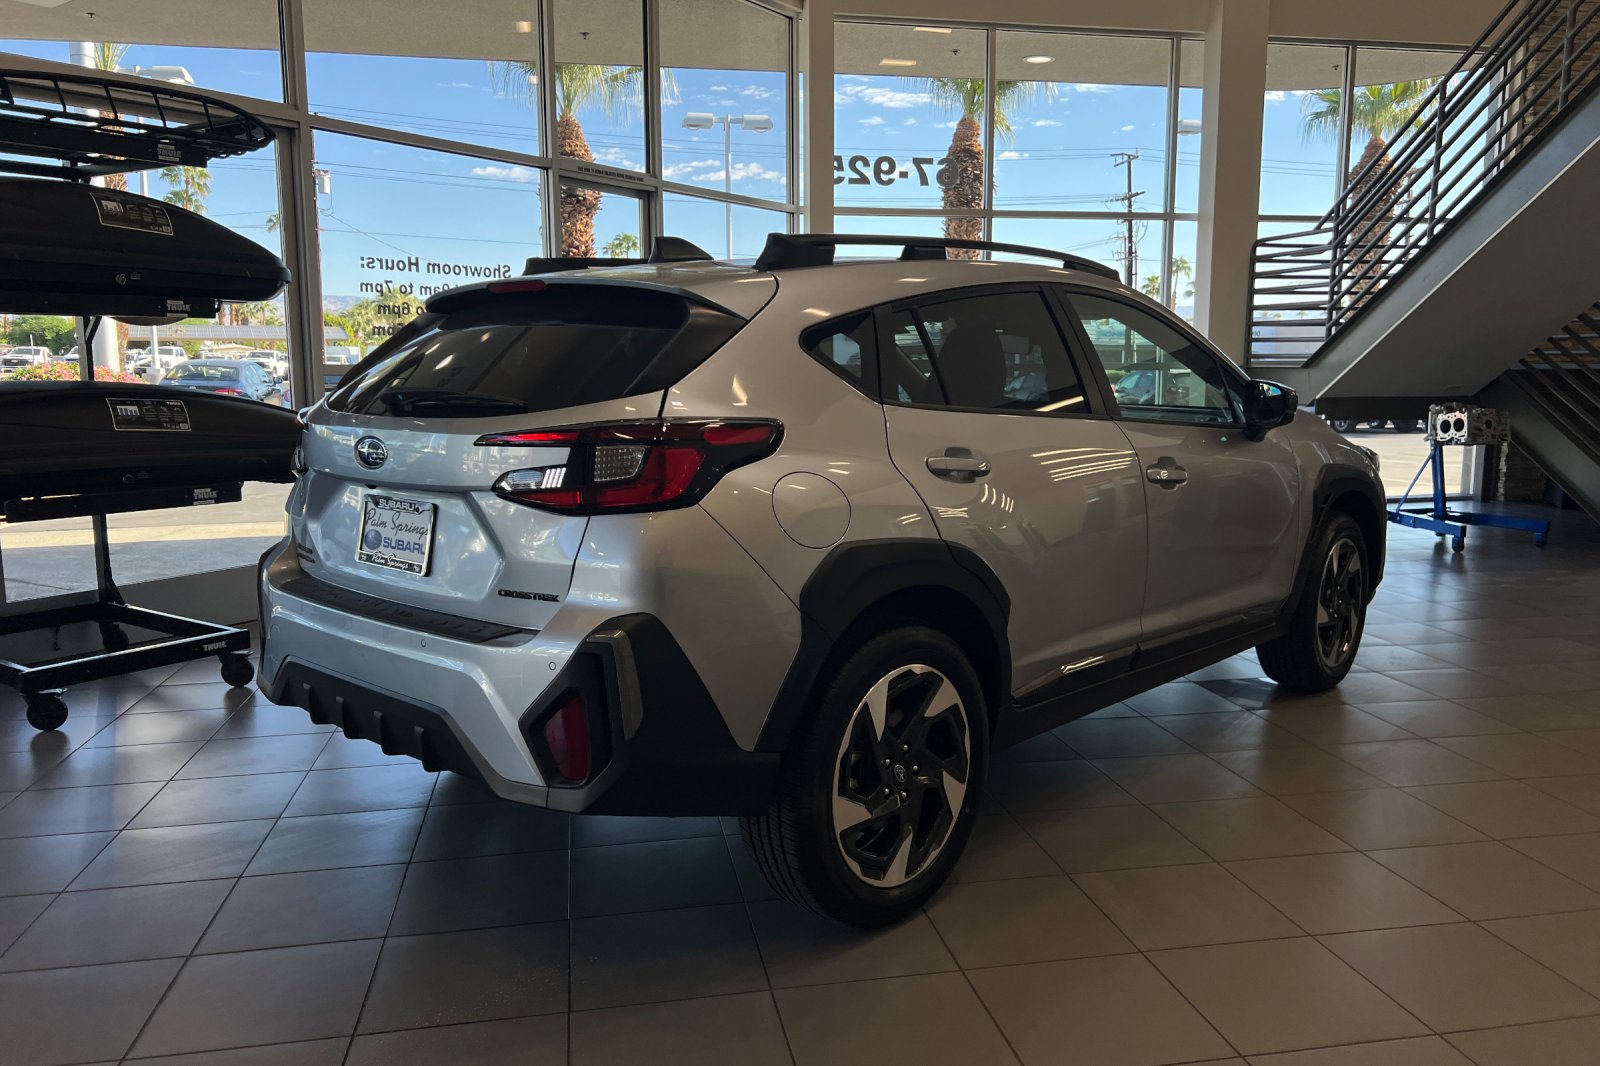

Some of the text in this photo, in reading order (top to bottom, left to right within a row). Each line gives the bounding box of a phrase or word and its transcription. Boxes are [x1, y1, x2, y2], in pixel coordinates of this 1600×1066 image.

[166, 303, 192, 312] THULE
[193, 491, 218, 500] THULE
[379, 498, 415, 511] SUBARU
[365, 508, 388, 526] Palm
[371, 551, 409, 569] Palm Springs
[497, 589, 561, 603] CROSSTREK
[203, 640, 228, 652] THULE
